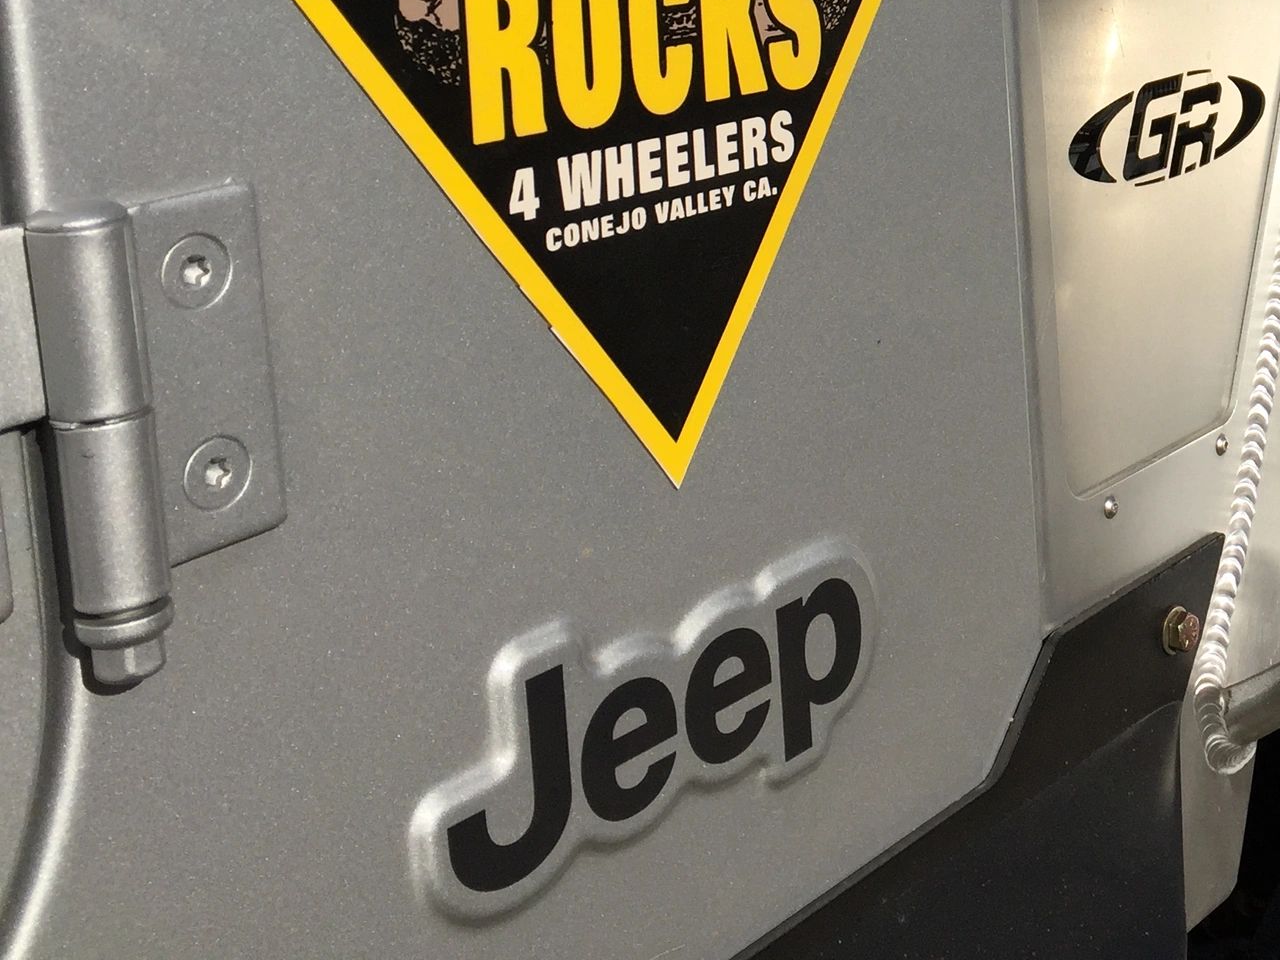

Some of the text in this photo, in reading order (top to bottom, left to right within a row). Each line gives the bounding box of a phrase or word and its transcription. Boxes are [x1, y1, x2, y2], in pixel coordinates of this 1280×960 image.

[508, 109, 796, 222] 4 WHEELERS
[545, 176, 778, 253] CONEJO VALLEY CA.
[446, 577, 862, 893] Jeep
